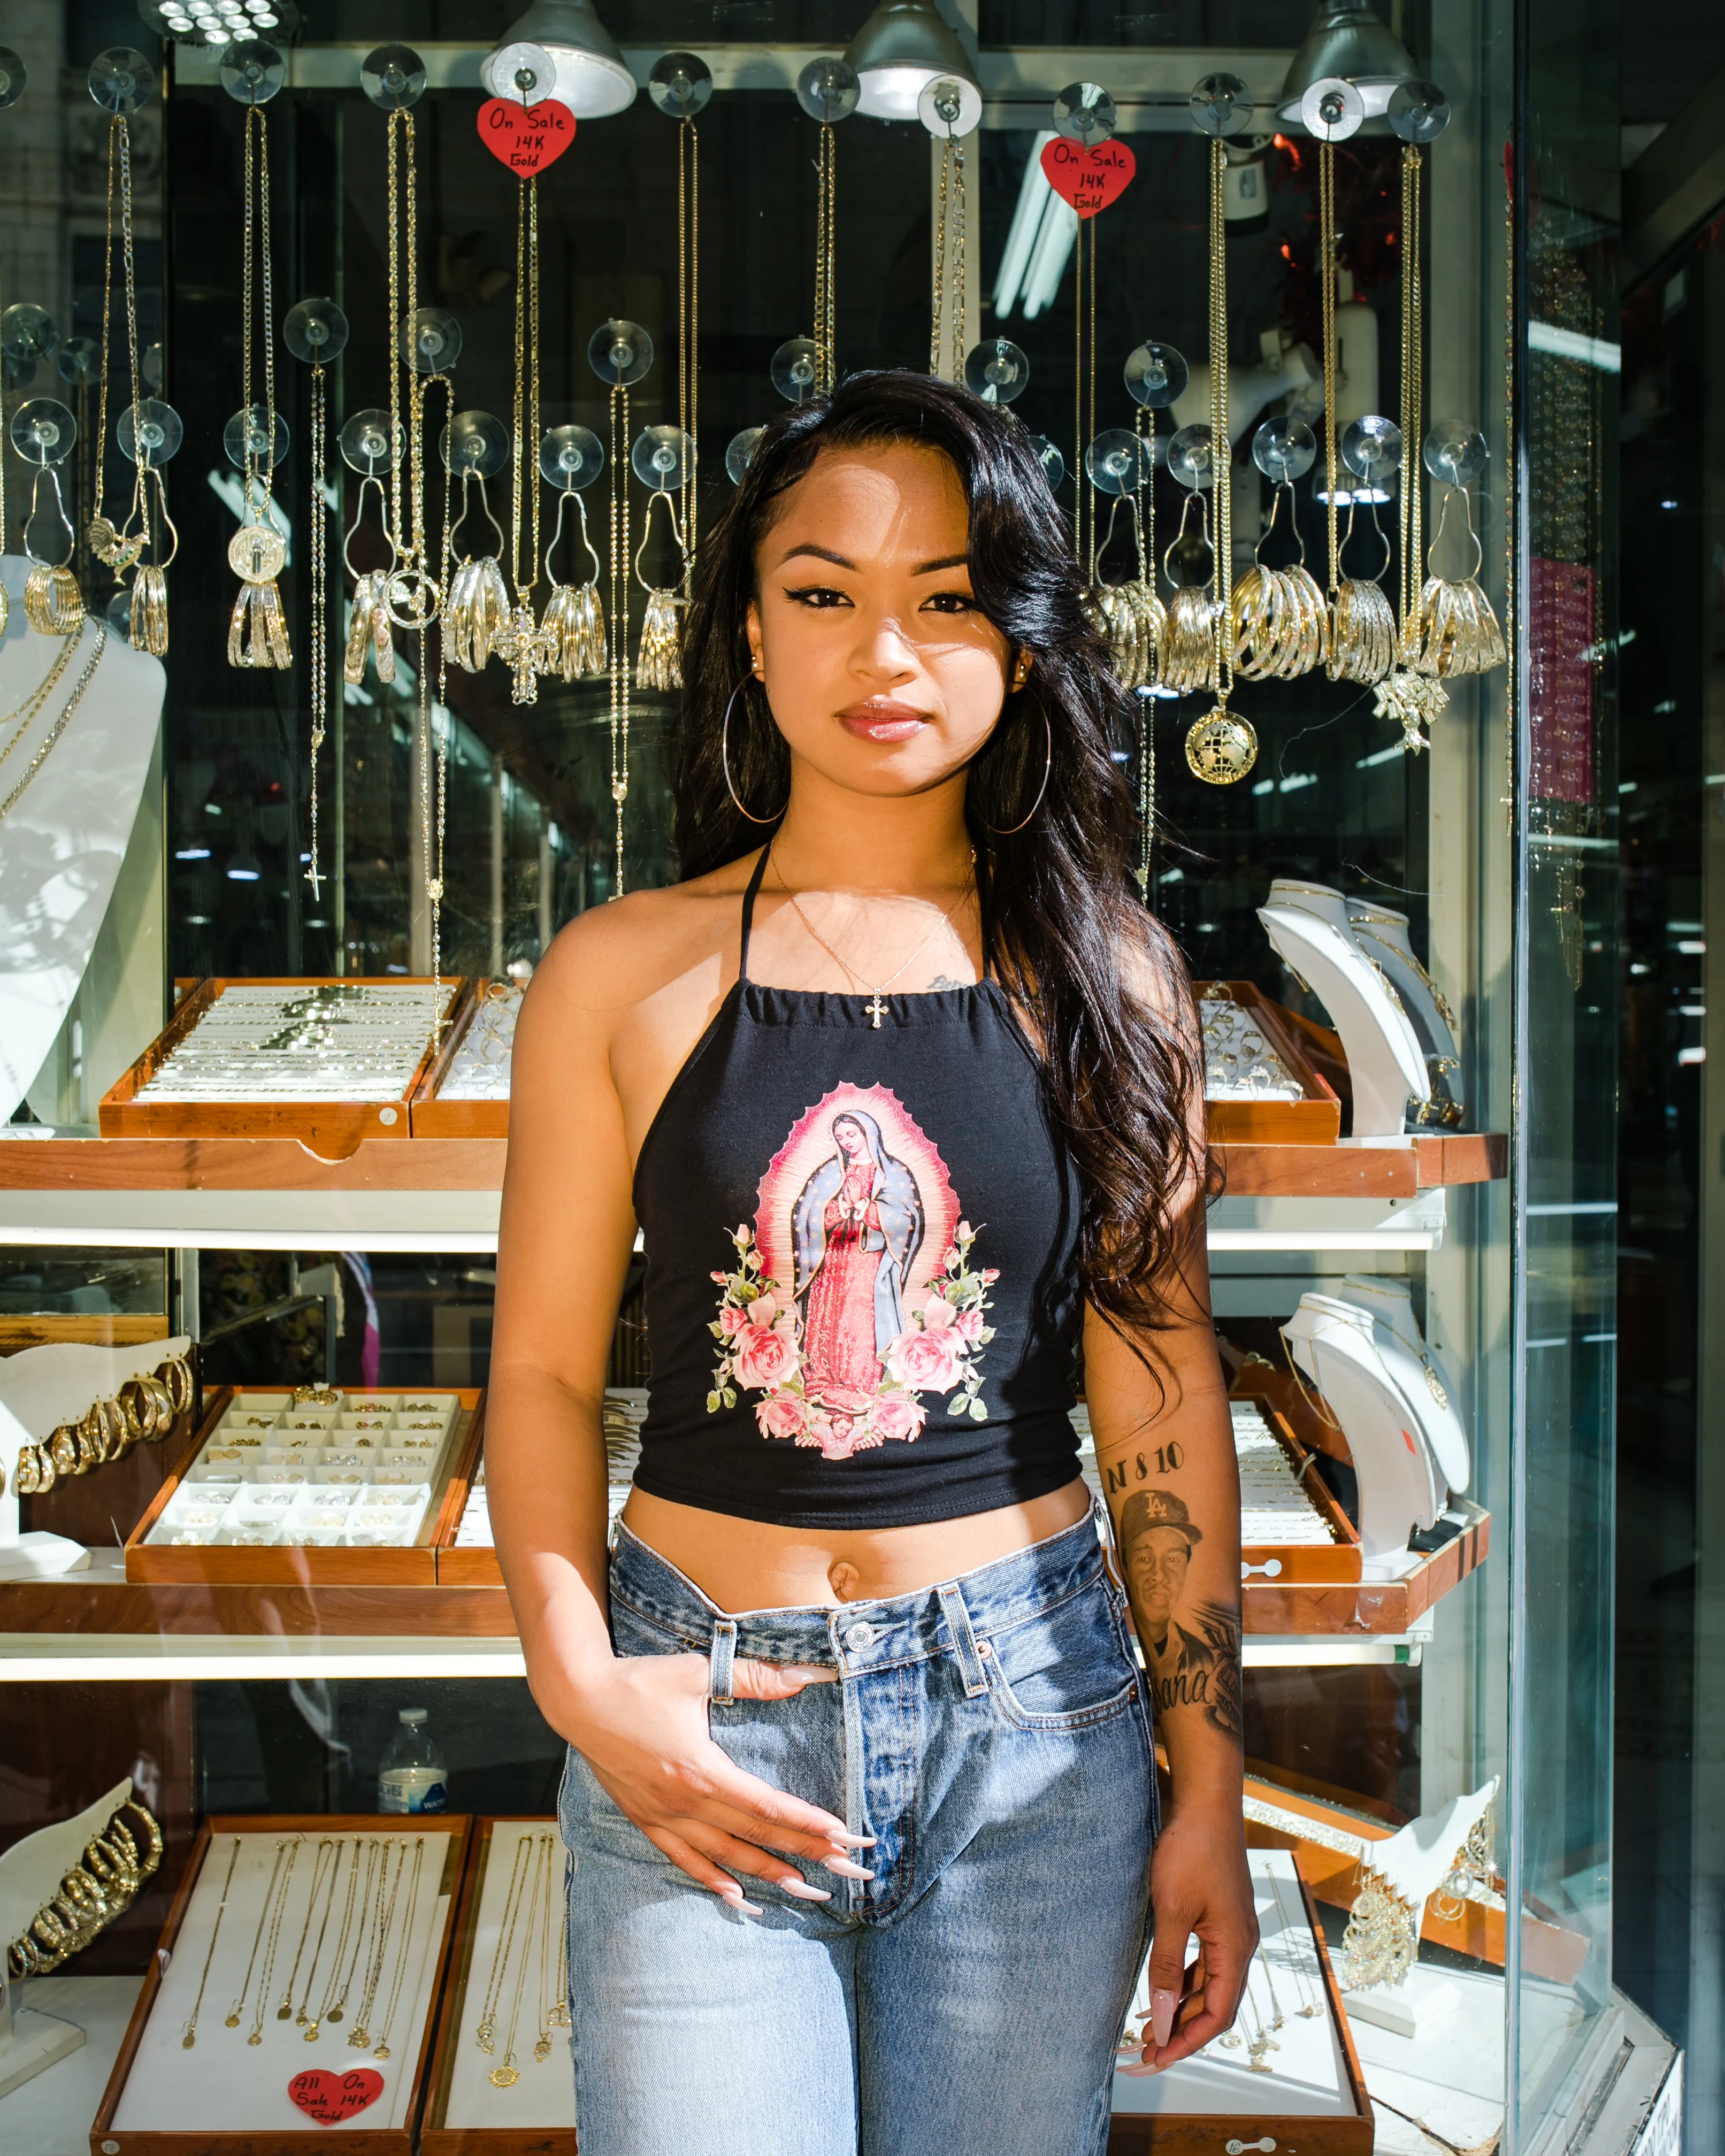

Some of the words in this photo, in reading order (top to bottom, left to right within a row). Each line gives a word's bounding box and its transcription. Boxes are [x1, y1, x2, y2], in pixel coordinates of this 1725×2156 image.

[489, 107, 513, 129] On
[527, 109, 565, 130] Sale
[516, 135, 545, 151] 14K
[510, 153, 539, 167] Gold
[1054, 143, 1078, 164] On
[1090, 149, 1126, 168] Sale
[1079, 173, 1106, 189] 14K
[1074, 193, 1103, 209] Gold
[382, 1113, 392, 1122] 2
[1107, 1459, 1127, 1494] N
[1154, 1441, 1184, 1474] 10
[1145, 1493, 1167, 1518] LA
[294, 2076, 320, 2090] All
[343, 2074, 365, 2090] On
[296, 2092, 328, 2106] Sale
[340, 2093, 371, 2106] 14K
[311, 2109, 343, 2121] Gold
